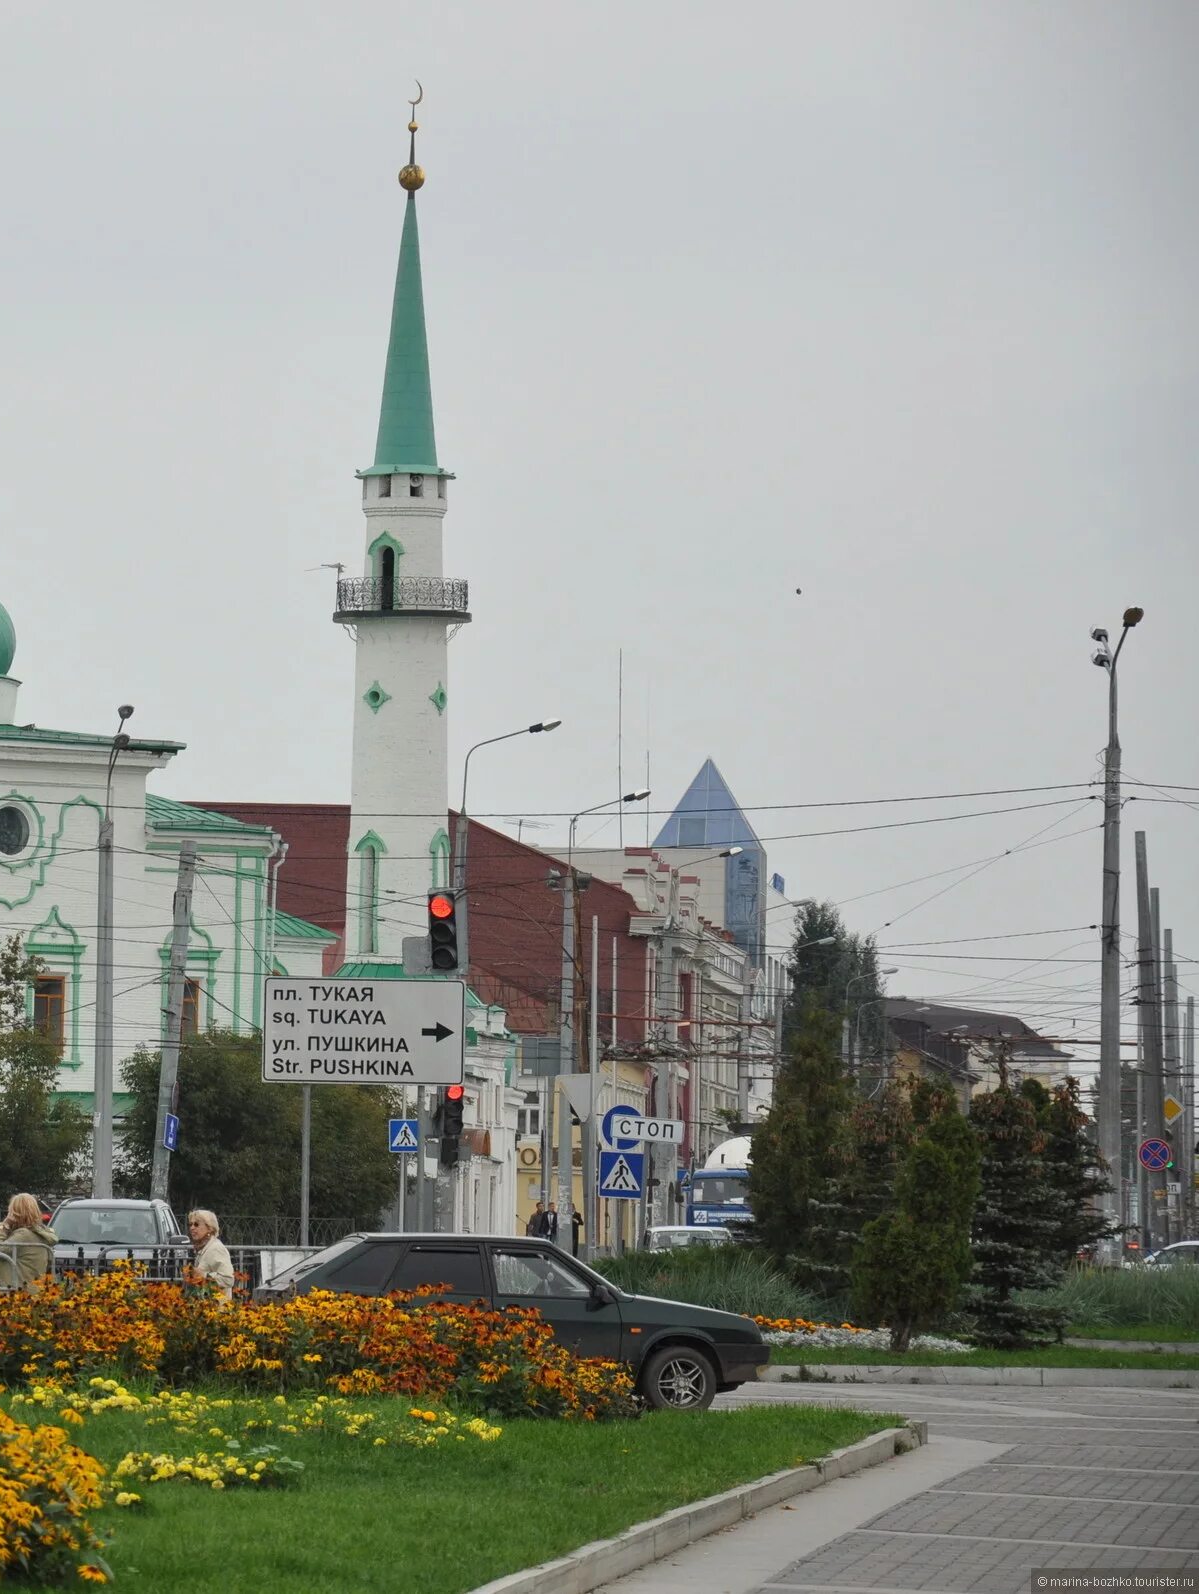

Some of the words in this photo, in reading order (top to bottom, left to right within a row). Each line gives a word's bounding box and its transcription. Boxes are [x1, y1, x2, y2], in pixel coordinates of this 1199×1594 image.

[273, 989, 302, 1001] пл.
[309, 986, 374, 1002] ТУКАЯ
[272, 1011, 300, 1027] sq.
[307, 1009, 386, 1025] TUKAYA
[272, 1039, 300, 1054] ул.
[307, 1036, 409, 1053] ПУШКИНА
[272, 1058, 303, 1074] Str.
[310, 1059, 414, 1076] PUSHKINA
[620, 1120, 674, 1139] СТОП
